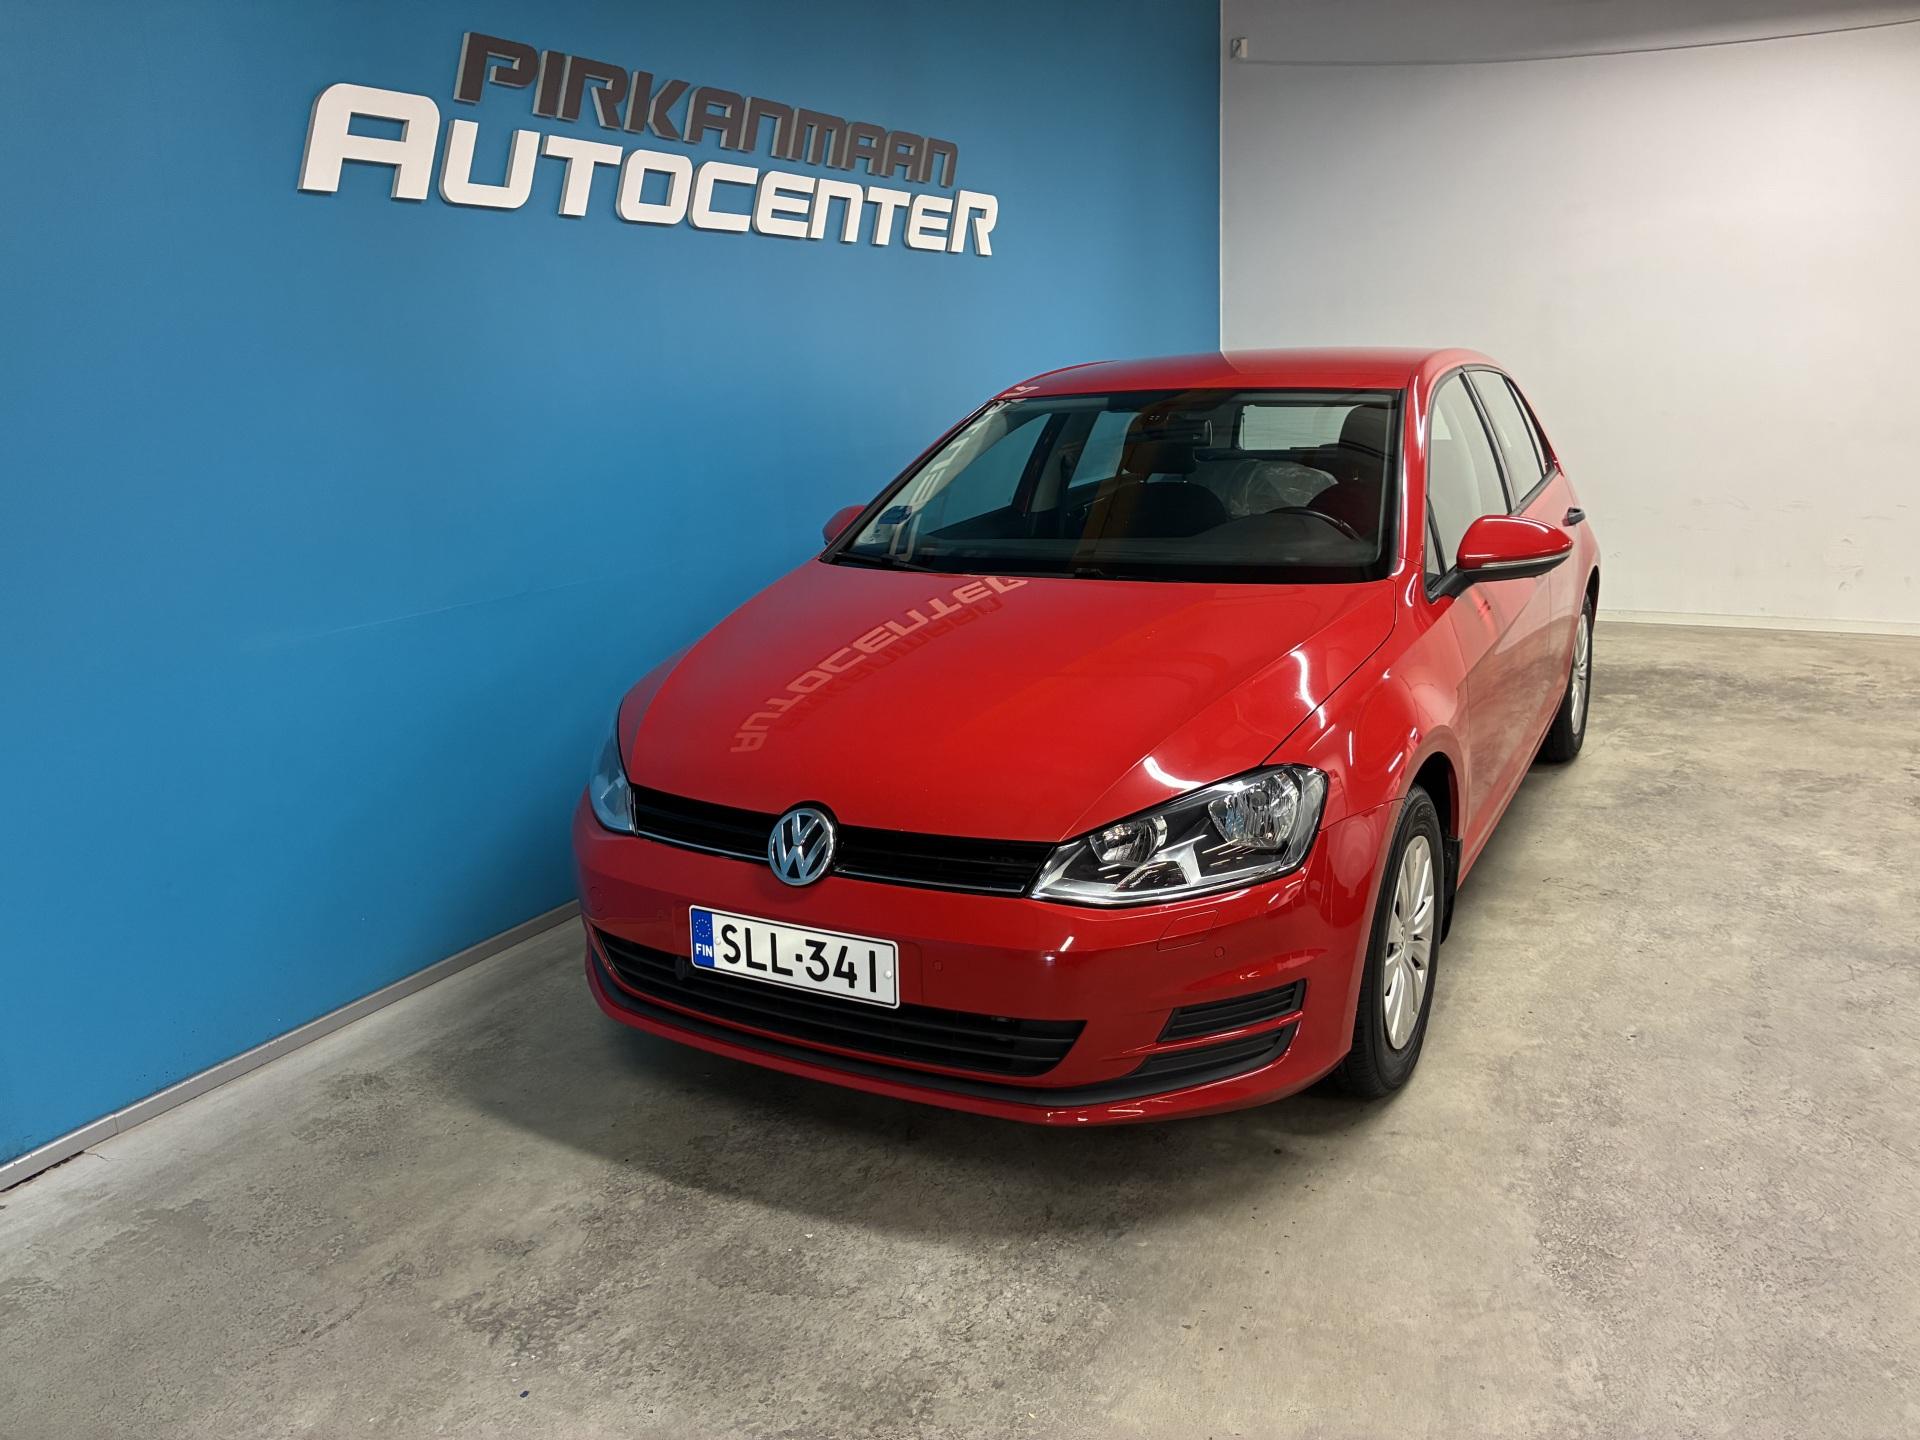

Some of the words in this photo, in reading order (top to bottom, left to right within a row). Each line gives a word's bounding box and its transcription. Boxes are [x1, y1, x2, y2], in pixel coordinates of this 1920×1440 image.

[454, 32, 959, 188] PIRKANMAAN
[298, 82, 999, 257] AUTOCENTER
[695, 943, 713, 958] FIN
[721, 924, 877, 993] SLL-341
